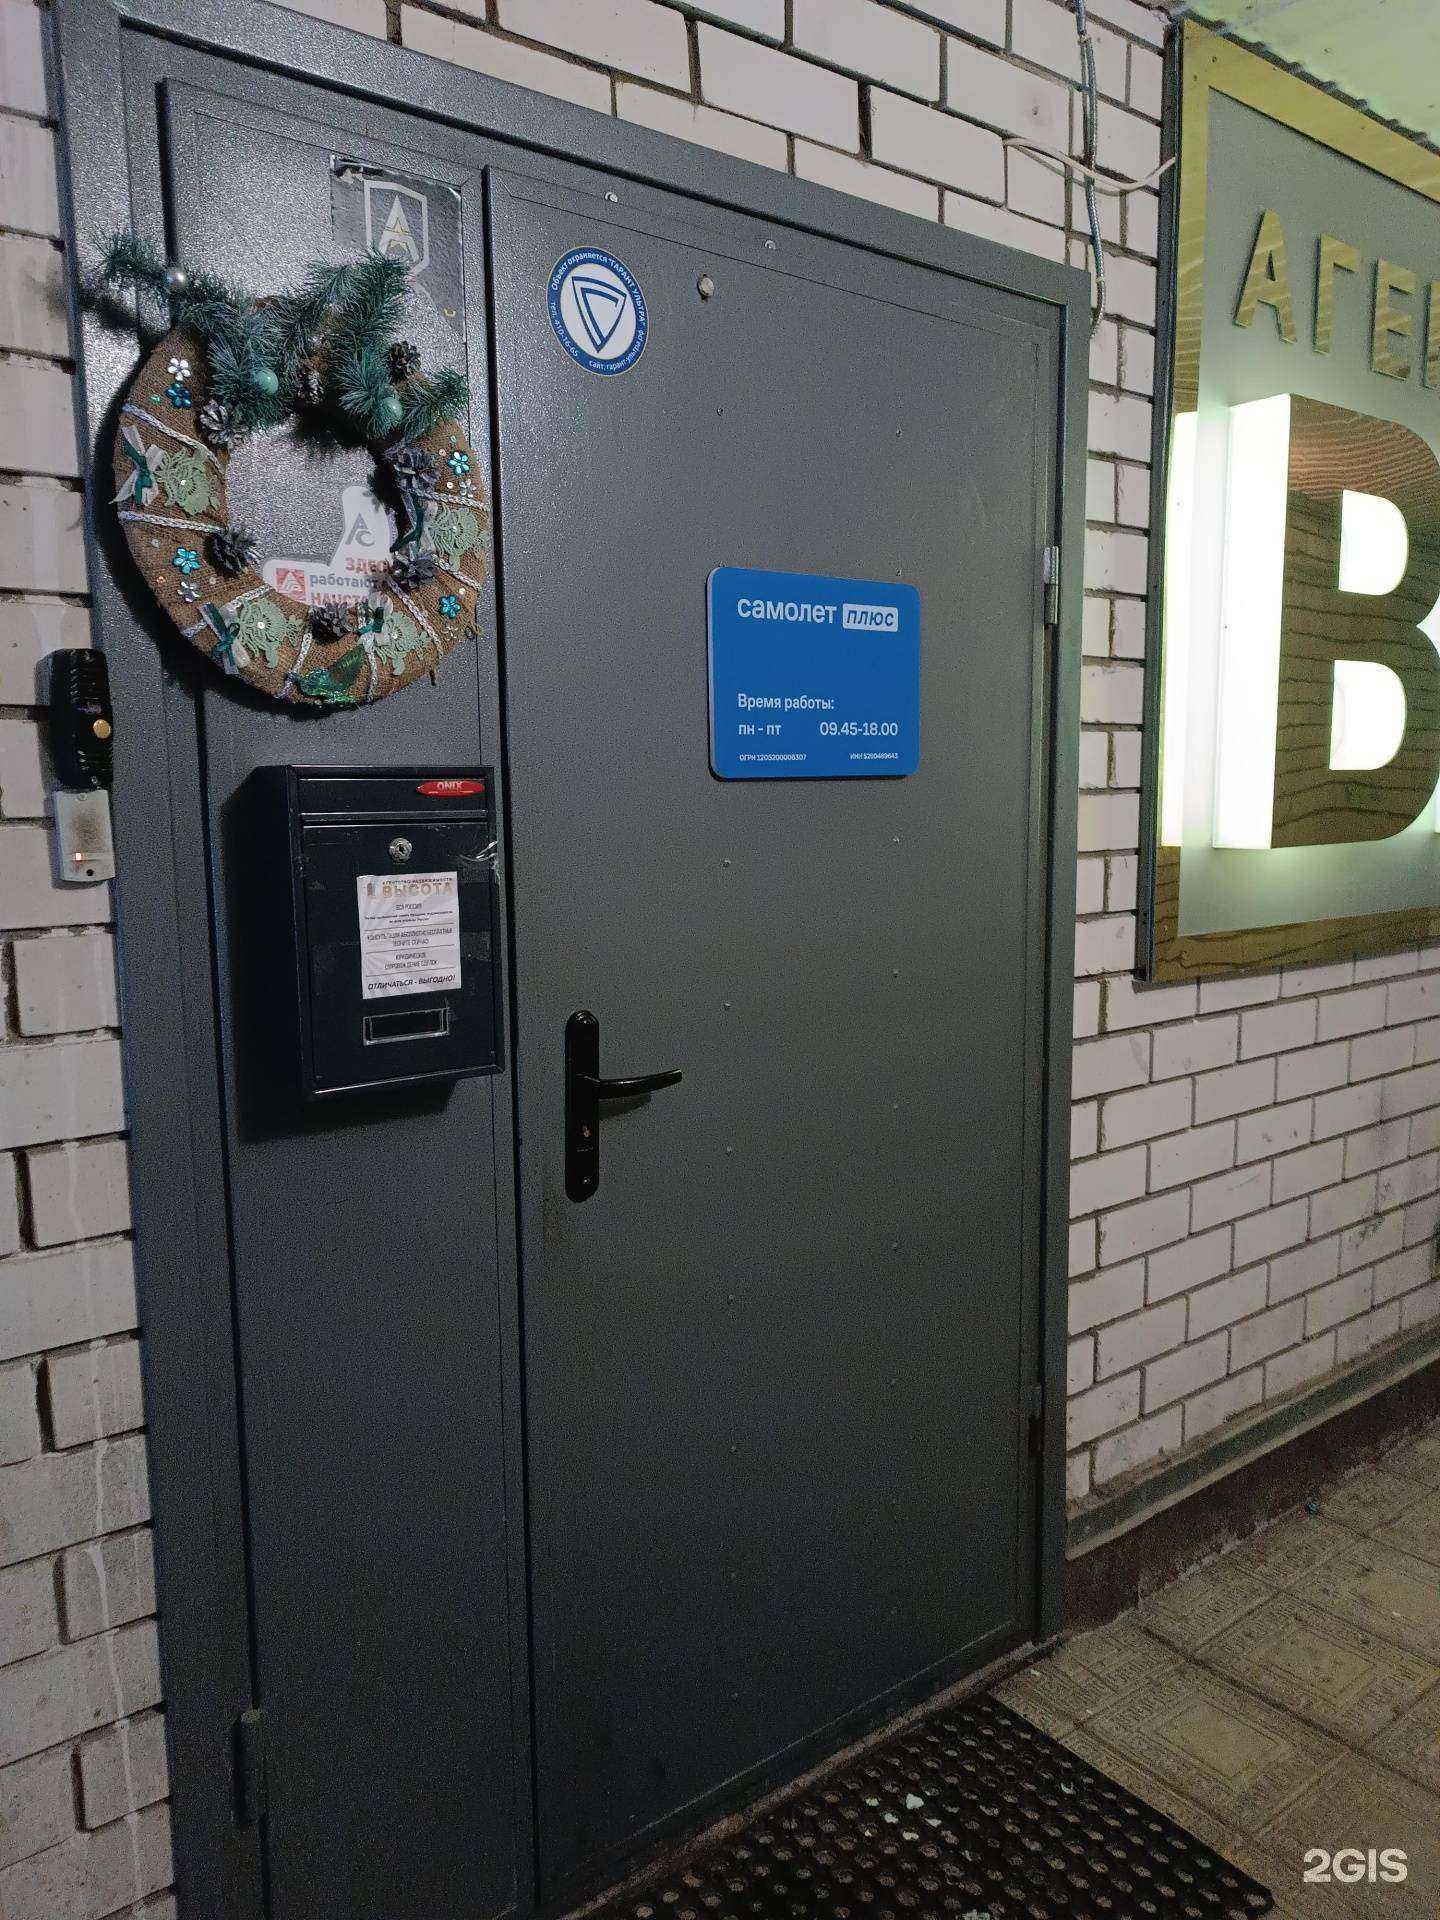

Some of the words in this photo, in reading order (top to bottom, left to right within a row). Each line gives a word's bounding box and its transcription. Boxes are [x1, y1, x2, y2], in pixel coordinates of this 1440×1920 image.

[551, 262, 569, 290] Объект
[567, 252, 608, 265] охраняется
[737, 598, 837, 624] самолет
[737, 694, 782, 711] Время
[784, 695, 835, 711] работы:
[738, 724, 755, 736] пн
[766, 724, 782, 736] пт
[819, 722, 899, 736] 09.45-18.00
[739, 753, 756, 761] ОГРН
[849, 752, 863, 760] ИНН
[436, 781, 463, 791] ONIX
[367, 979, 414, 990] ОТЛИЧАТЬСЯ
[418, 974, 456, 985] ВЫГОДНО!
